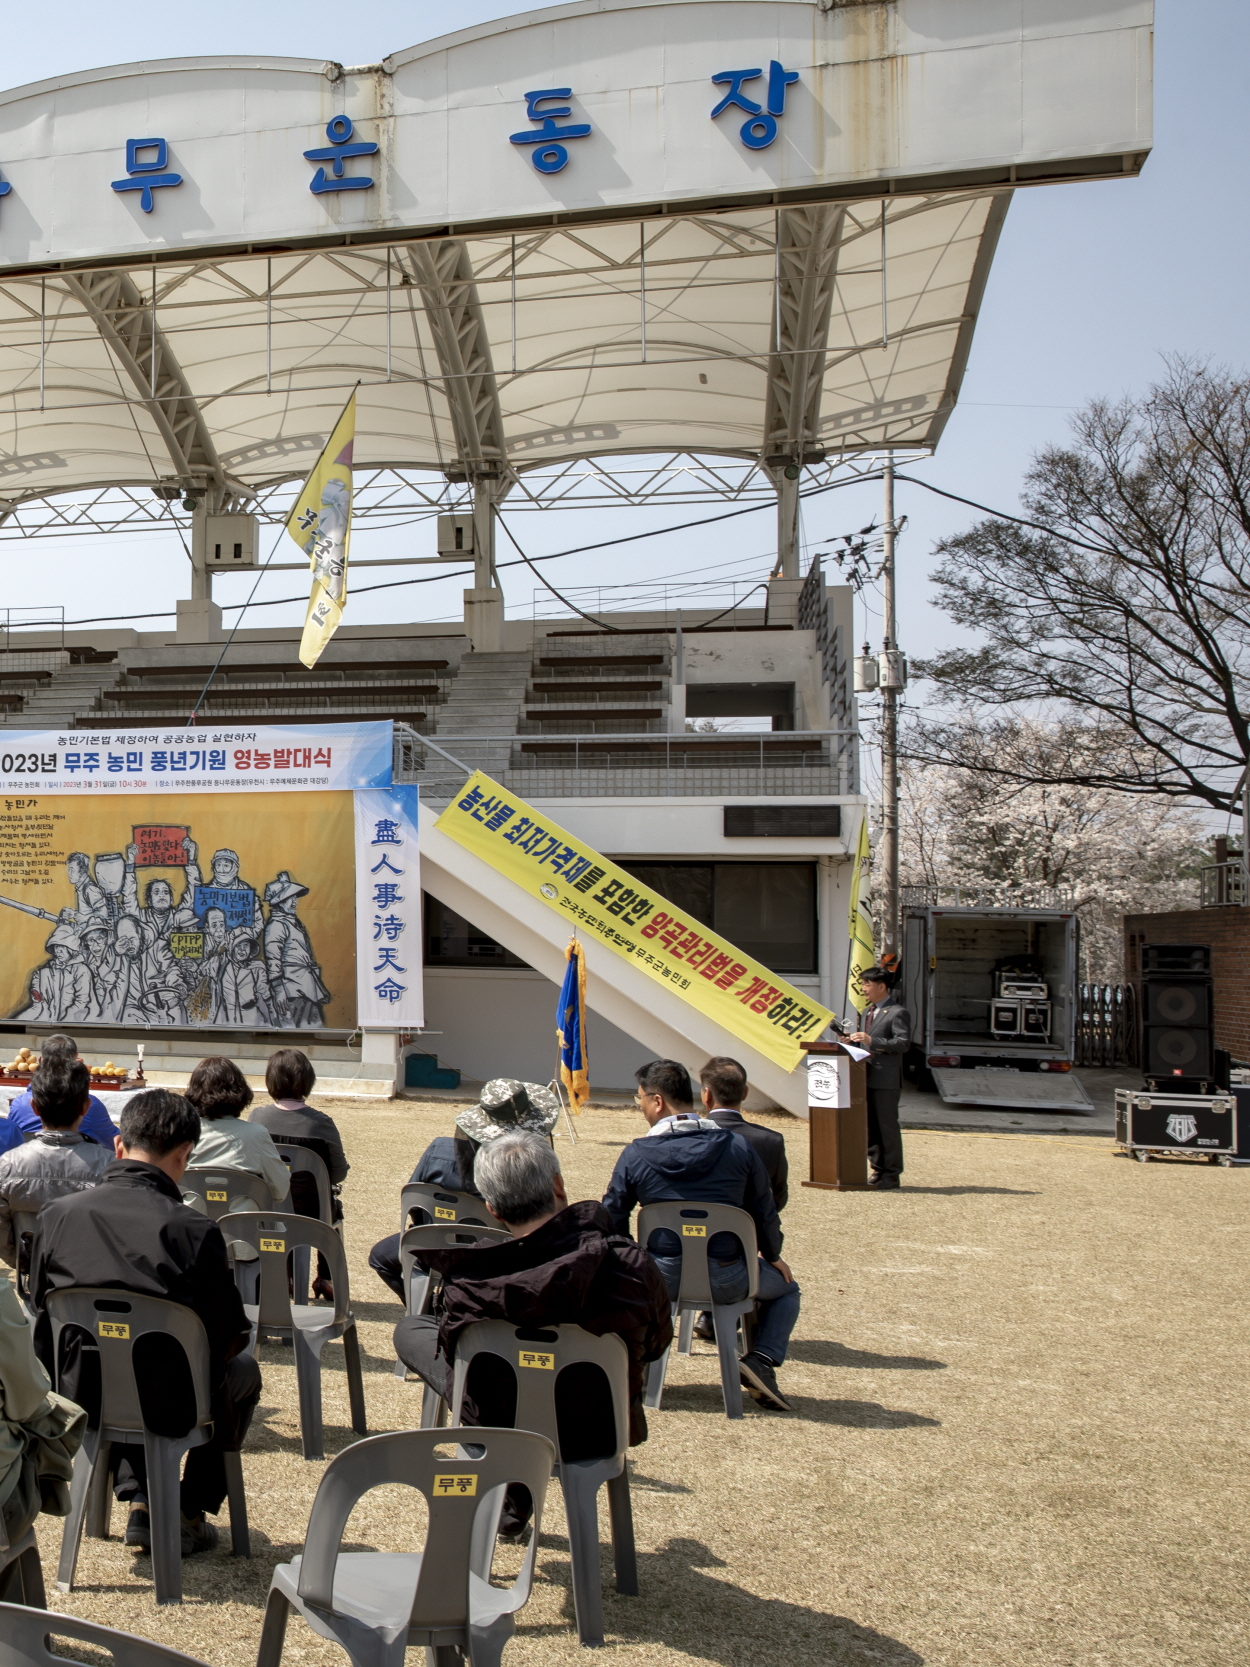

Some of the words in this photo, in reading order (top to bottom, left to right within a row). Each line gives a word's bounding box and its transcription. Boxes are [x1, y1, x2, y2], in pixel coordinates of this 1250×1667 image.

[57, 735, 111, 746] 농민기본법
[114, 735, 159, 745] 제정하여
[163, 734, 207, 744] 공공농업
[211, 732, 257, 742] 실현하자
[64, 752, 100, 773] 무주
[107, 751, 143, 773] 농민
[150, 750, 226, 772] 풍년기원
[233, 747, 332, 770] 영농발대식
[5, 799, 38, 811] 농민가
[198, 889, 251, 909] 농민기본법
[456, 784, 517, 833] 농산물
[503, 816, 607, 895] 최저가격제를
[592, 878, 654, 927] 포함한
[639, 911, 749, 991] 양곡관리법을
[735, 975, 822, 1039] 개정하라!
[171, 934, 202, 946] CPTPP
[208, 1192, 225, 1200] 무풍
[437, 1208, 454, 1219] 무풍
[685, 1226, 704, 1235] 무풍
[263, 1240, 283, 1251] 무풍
[102, 1324, 127, 1336] 무풍
[522, 1353, 551, 1367] 무풍
[438, 1477, 473, 1493] 무풍
